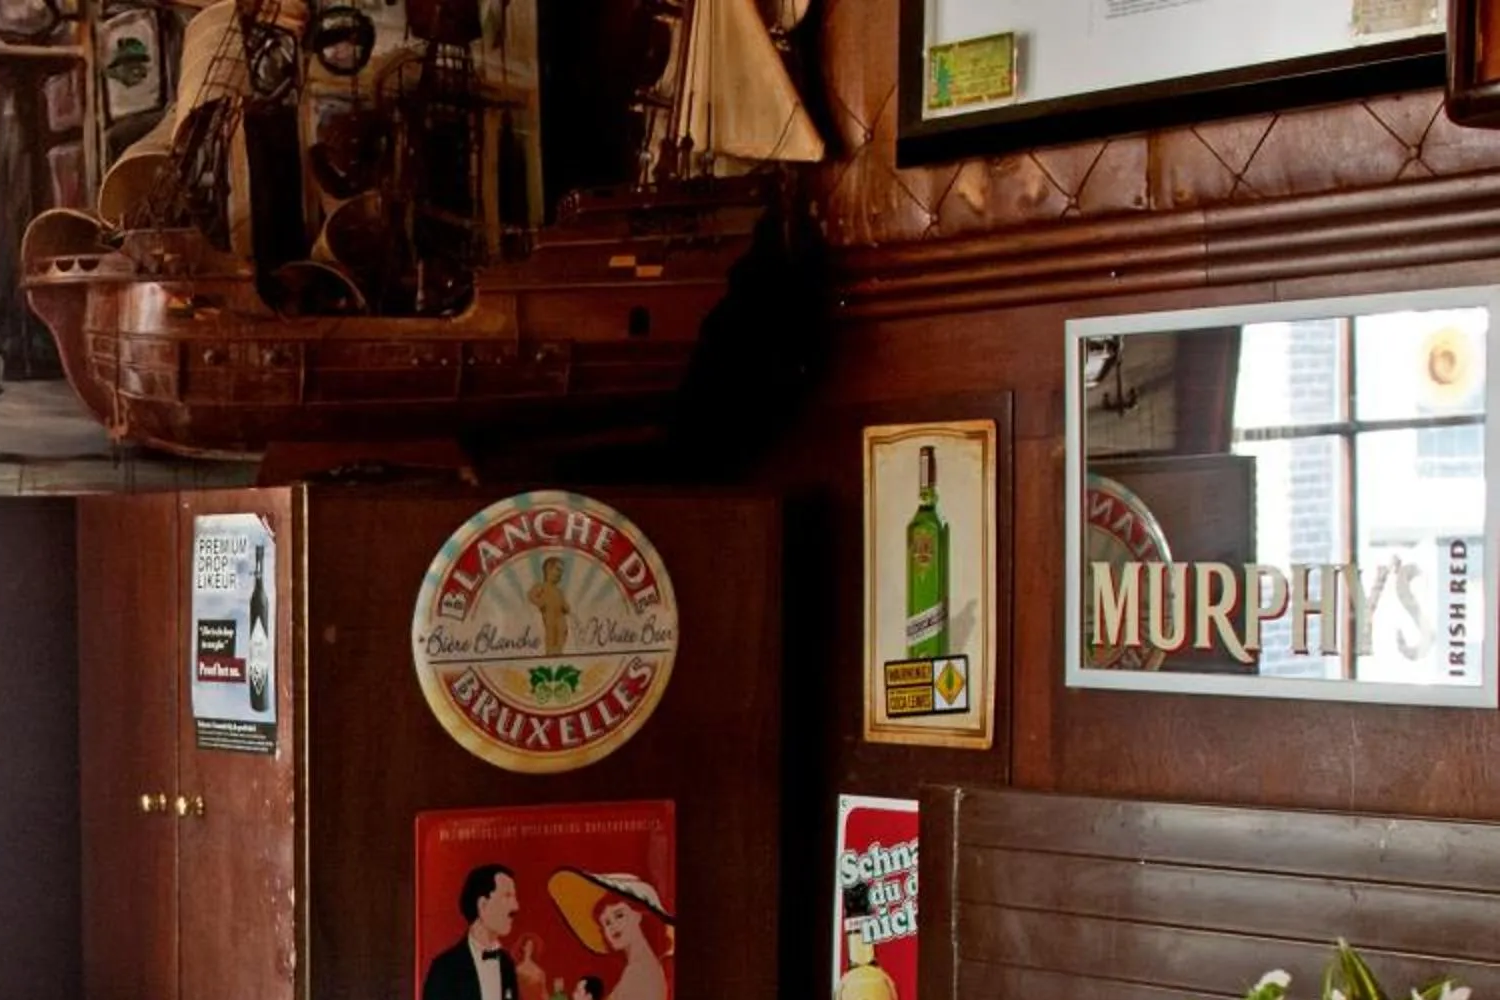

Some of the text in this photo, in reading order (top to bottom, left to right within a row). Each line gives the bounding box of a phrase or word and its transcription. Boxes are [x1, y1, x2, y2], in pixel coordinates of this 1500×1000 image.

[198, 555, 229, 572] DROP
[199, 537, 247, 555] PREMIUM
[441, 508, 661, 621] BLANCHE DE
[1089, 554, 1436, 664] MURPHY'S
[1448, 539, 1469, 677] IRISH RED
[453, 656, 654, 750] BRUXELLES
[869, 879, 901, 905] du
